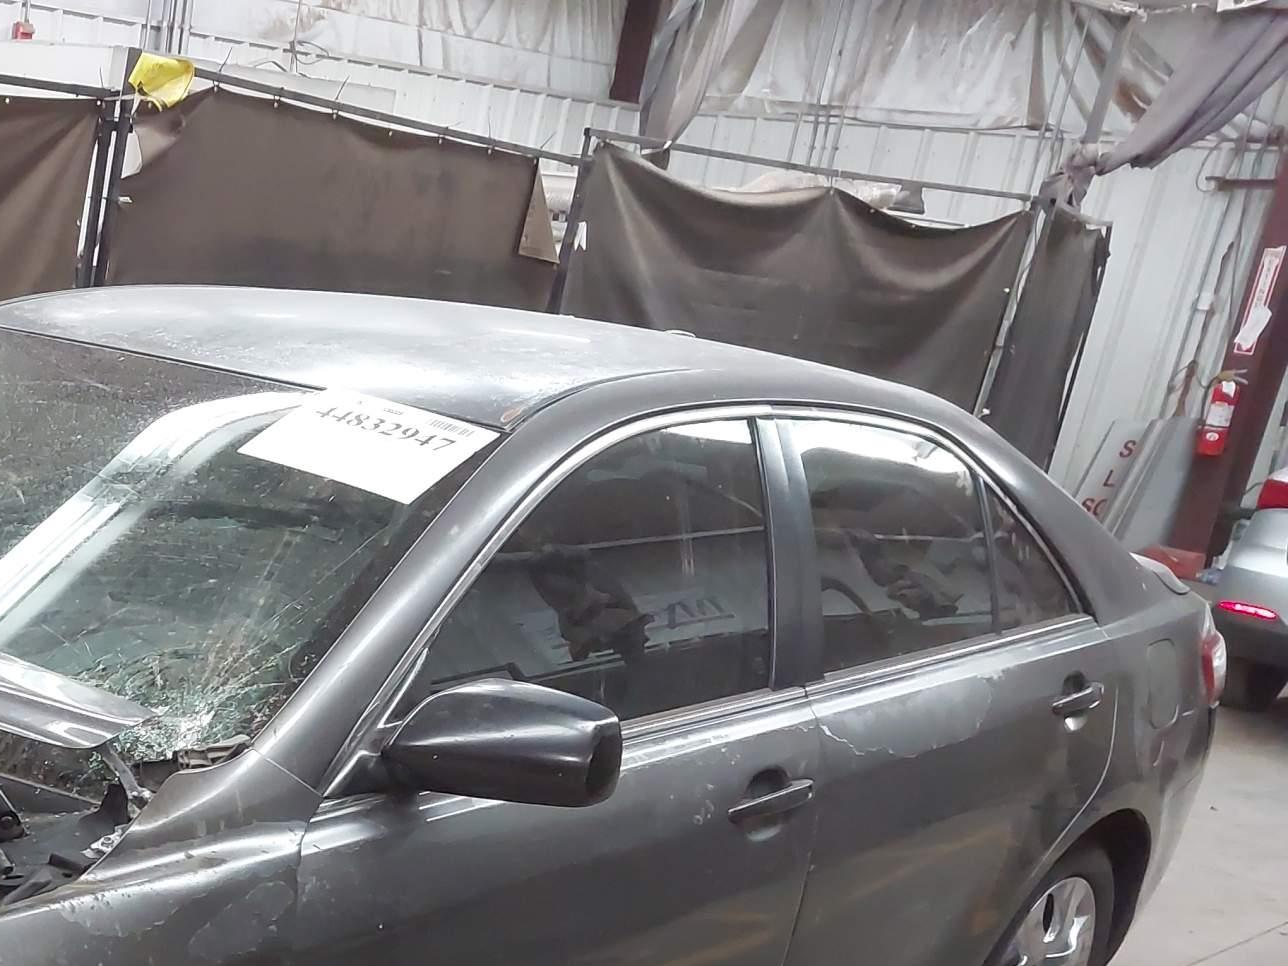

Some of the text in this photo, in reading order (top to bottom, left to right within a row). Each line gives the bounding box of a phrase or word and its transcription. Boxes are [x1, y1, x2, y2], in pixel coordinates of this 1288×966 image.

[315, 406, 457, 451] 44832947
[1119, 439, 1137, 458] S
[1103, 470, 1115, 487] L
